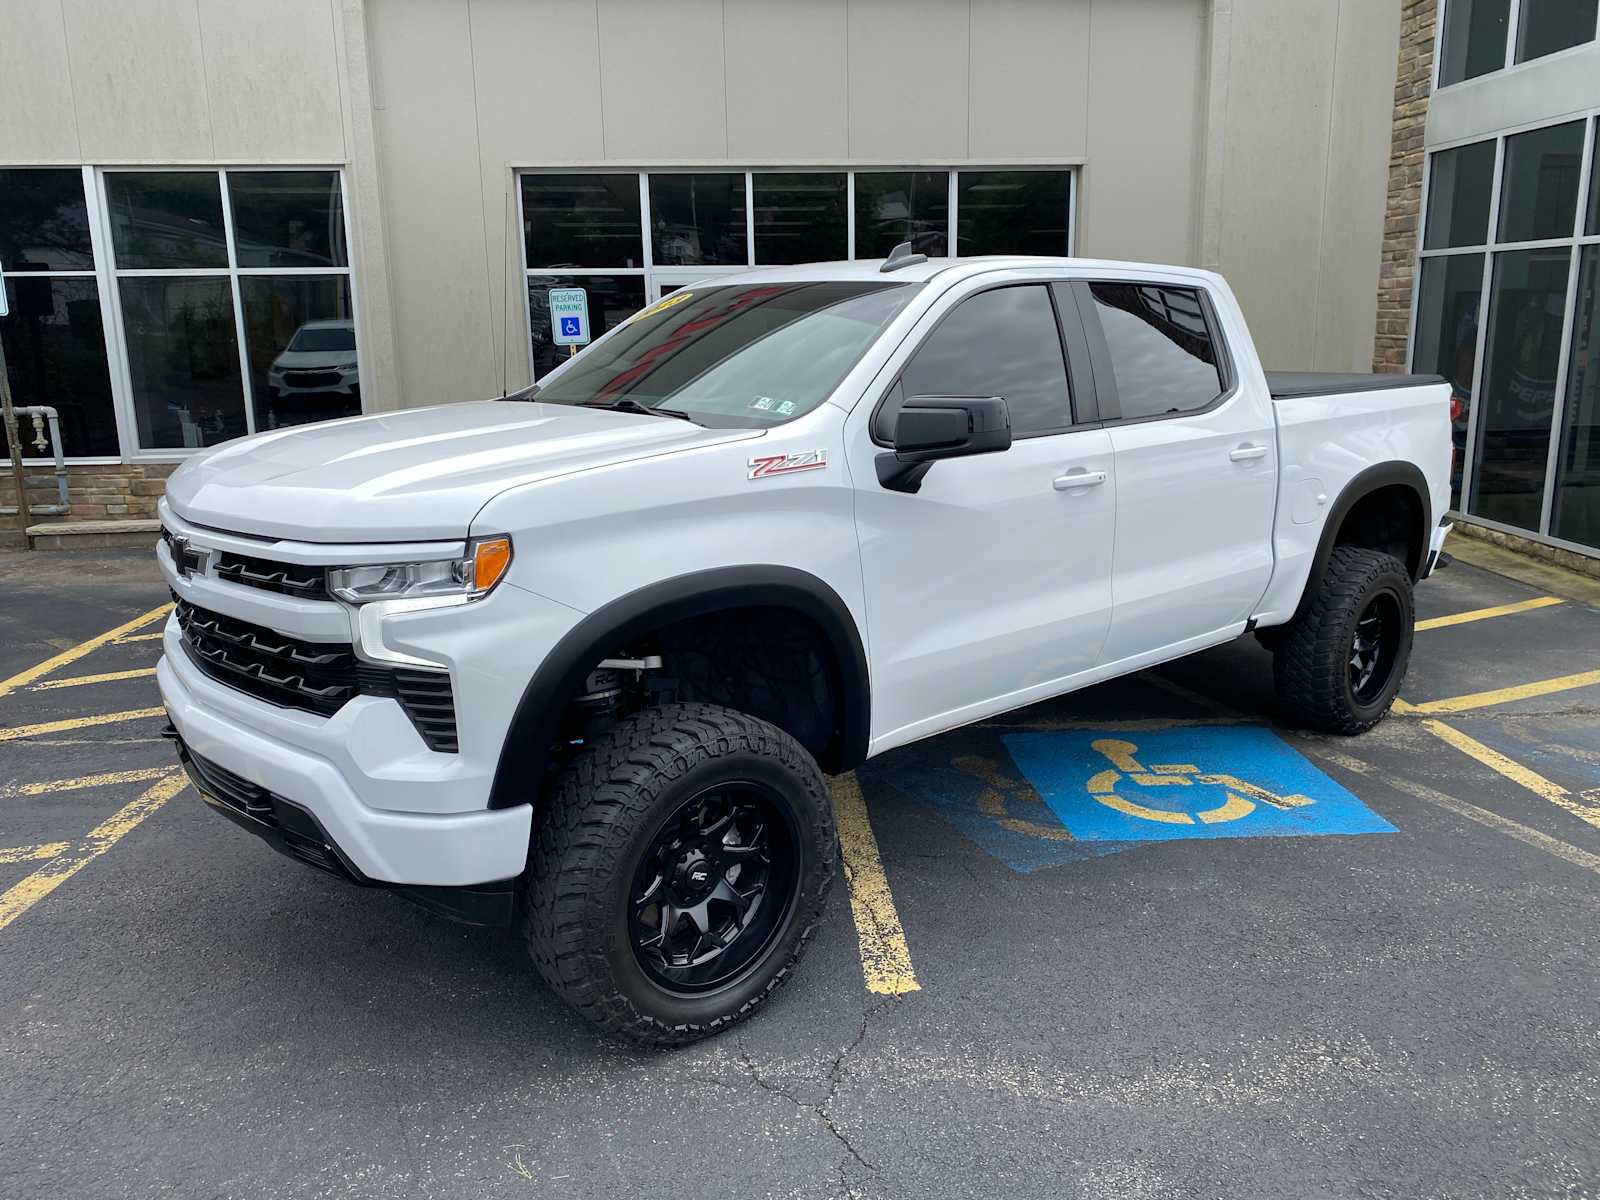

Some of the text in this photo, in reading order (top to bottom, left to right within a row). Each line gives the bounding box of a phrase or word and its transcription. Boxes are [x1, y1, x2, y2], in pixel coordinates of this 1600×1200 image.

[553, 294, 584, 303] RESERVED
[556, 304, 583, 312] PARKING
[1509, 379, 1553, 403] PEPS
